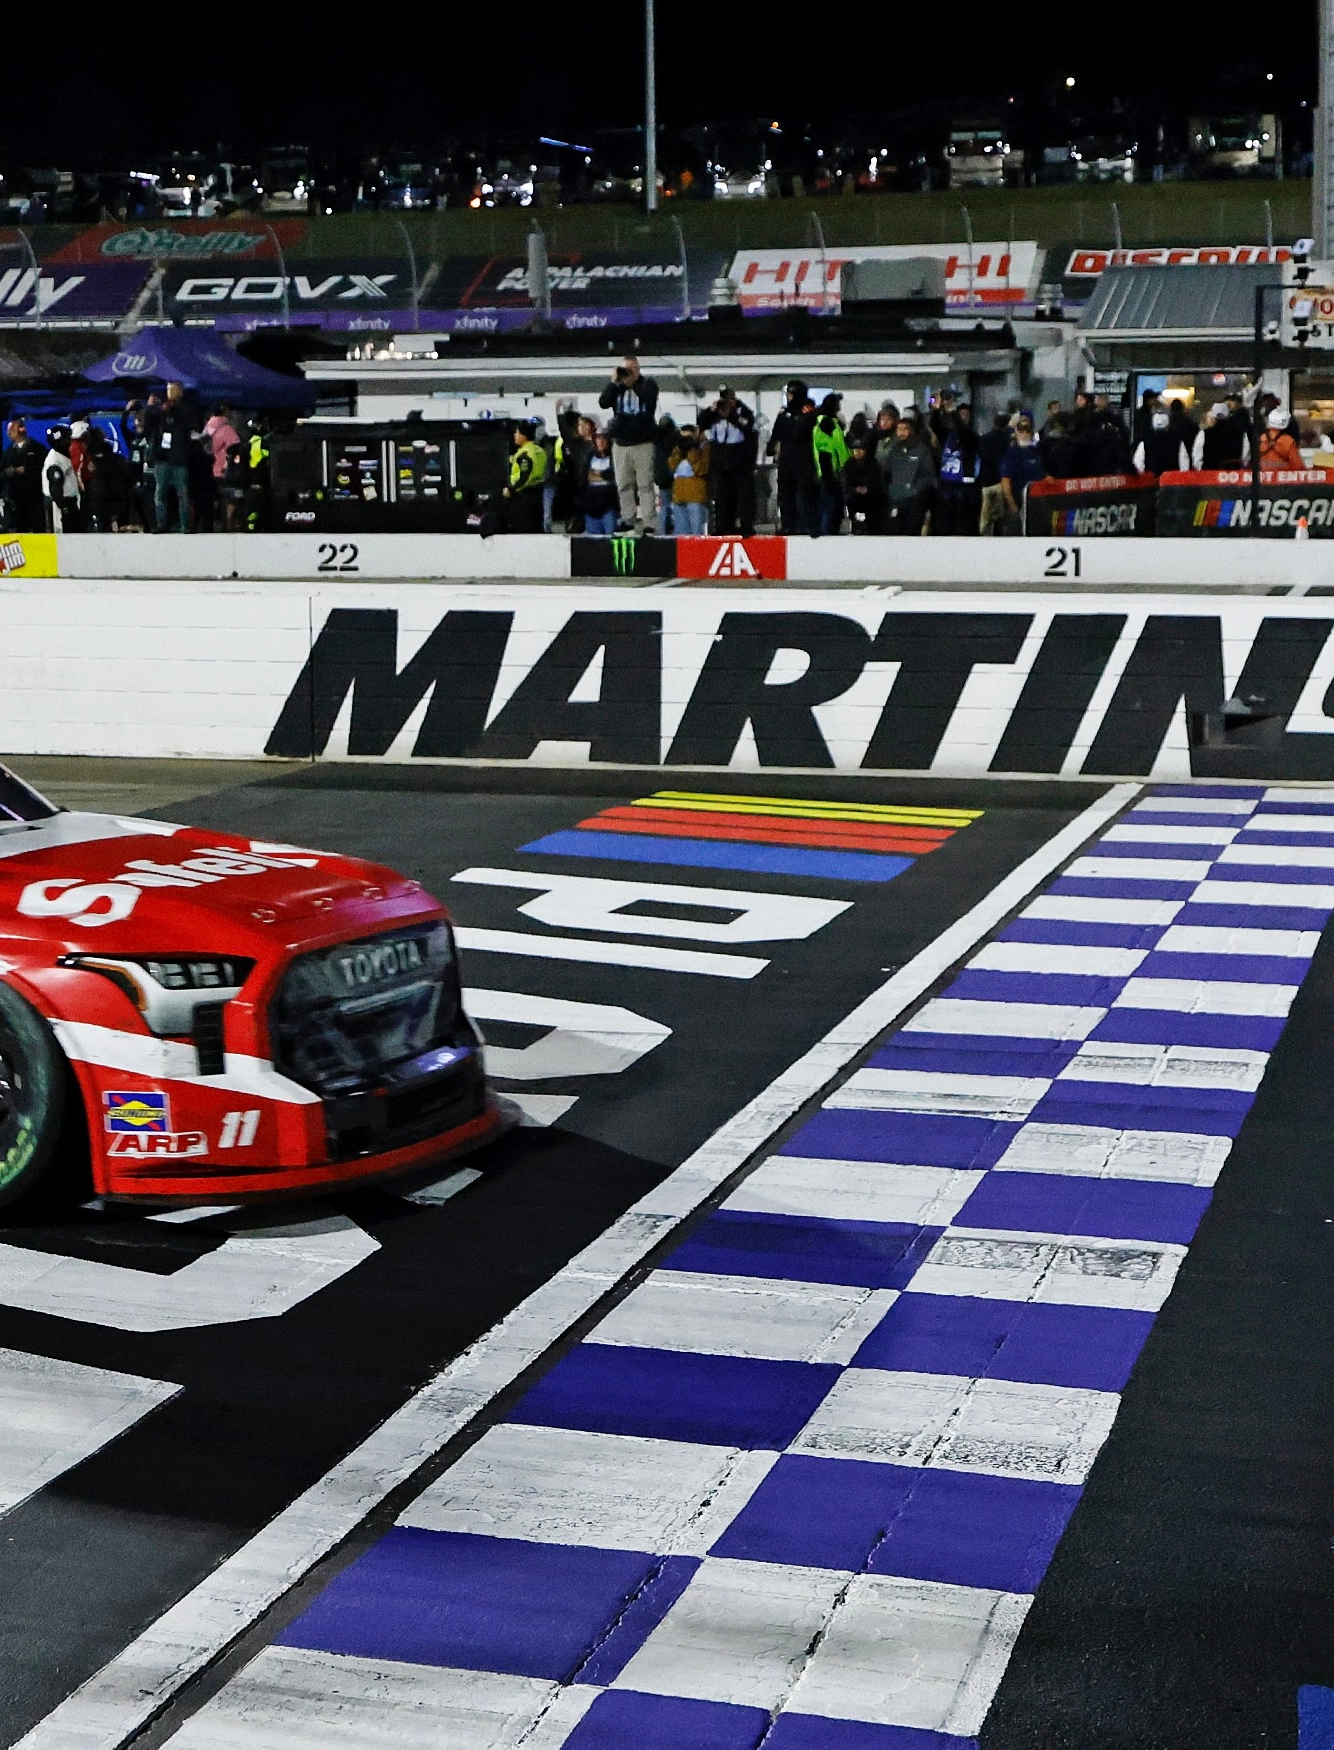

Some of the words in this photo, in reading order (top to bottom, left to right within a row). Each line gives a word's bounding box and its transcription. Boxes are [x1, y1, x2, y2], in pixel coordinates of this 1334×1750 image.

[744, 255, 1012, 284] HITHI
[175, 274, 397, 300] GOVX
[348, 317, 391, 332] xfinity
[454, 315, 498, 330] xfinity
[1217, 470, 1235, 483] DO
[1277, 470, 1327, 483] ENTER
[285, 511, 316, 521] FORD
[1073, 504, 1138, 535] NASCAR
[317, 543, 360, 572] 22
[1043, 547, 1081, 577] 21
[341, 938, 423, 986] TOYOTA
[218, 1110, 261, 1149] 11
[110, 1132, 207, 1155] ARP
